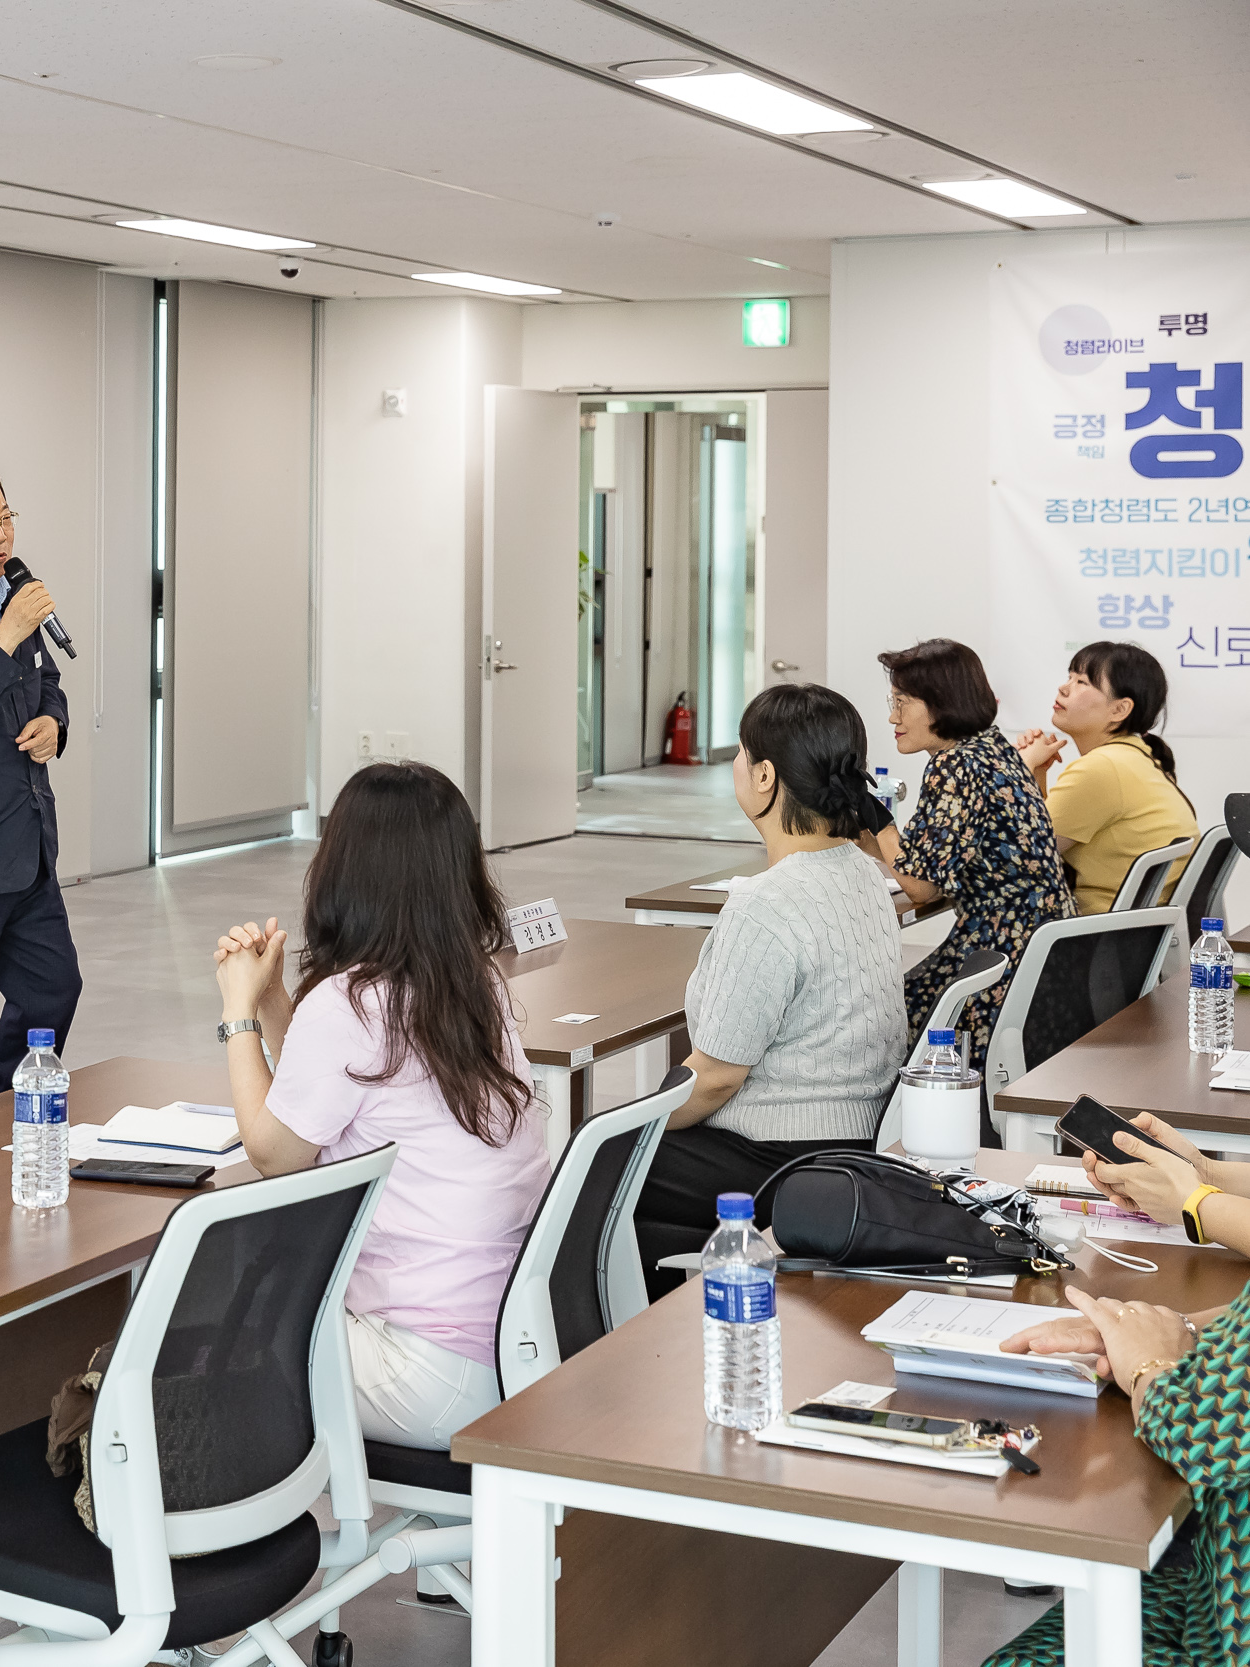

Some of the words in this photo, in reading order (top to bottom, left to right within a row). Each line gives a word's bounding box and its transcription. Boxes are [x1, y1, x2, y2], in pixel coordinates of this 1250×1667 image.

[1158, 312, 1208, 337] 투명
[1063, 338, 1145, 356] 청렴라이브
[1053, 414, 1106, 439] 긍정
[1124, 361, 1244, 480] 청
[1077, 445, 1105, 459] 책임
[1045, 497, 1179, 524] 종합청렴도
[1079, 547, 1240, 578] 청렴지킴이
[1097, 593, 1174, 629] 향상
